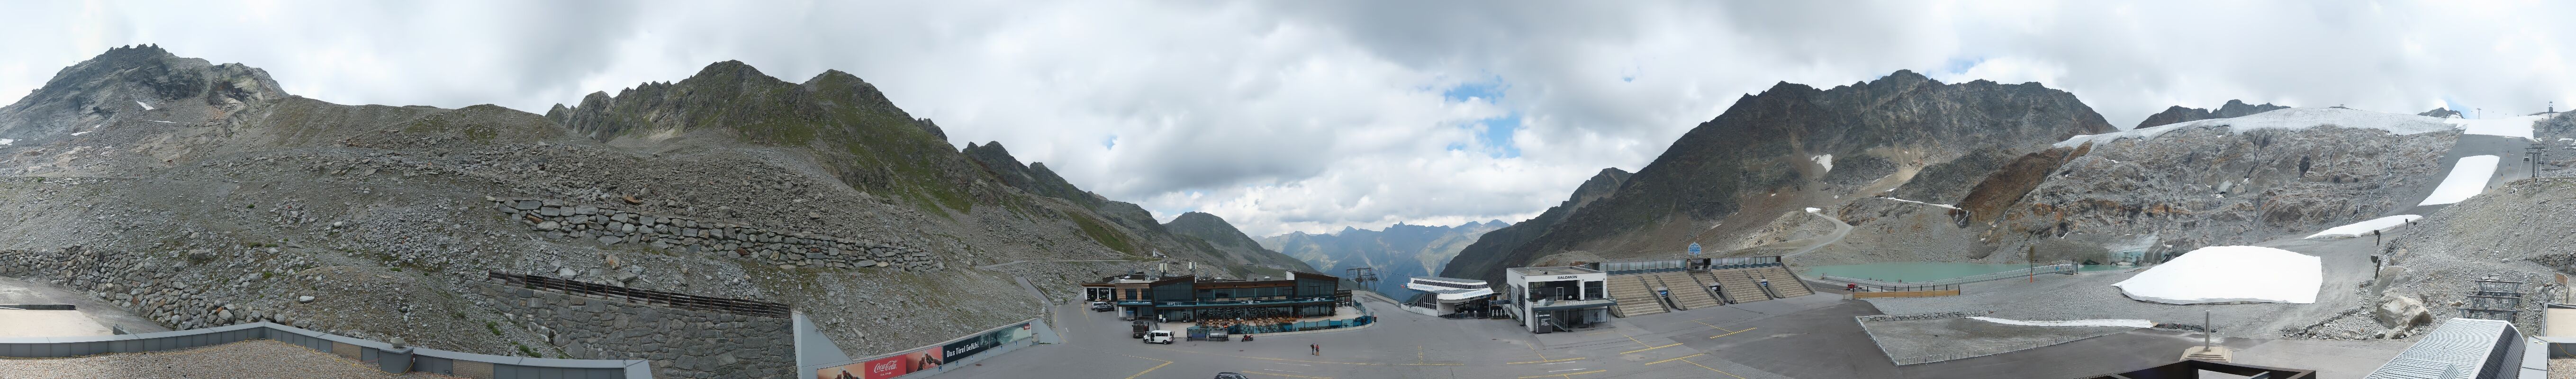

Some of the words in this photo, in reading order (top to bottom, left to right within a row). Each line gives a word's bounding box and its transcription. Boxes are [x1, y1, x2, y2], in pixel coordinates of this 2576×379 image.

[956, 345, 966, 355] Tirol
[966, 341, 979, 352] Gefühl
[874, 360, 898, 373] Coca-Cola
